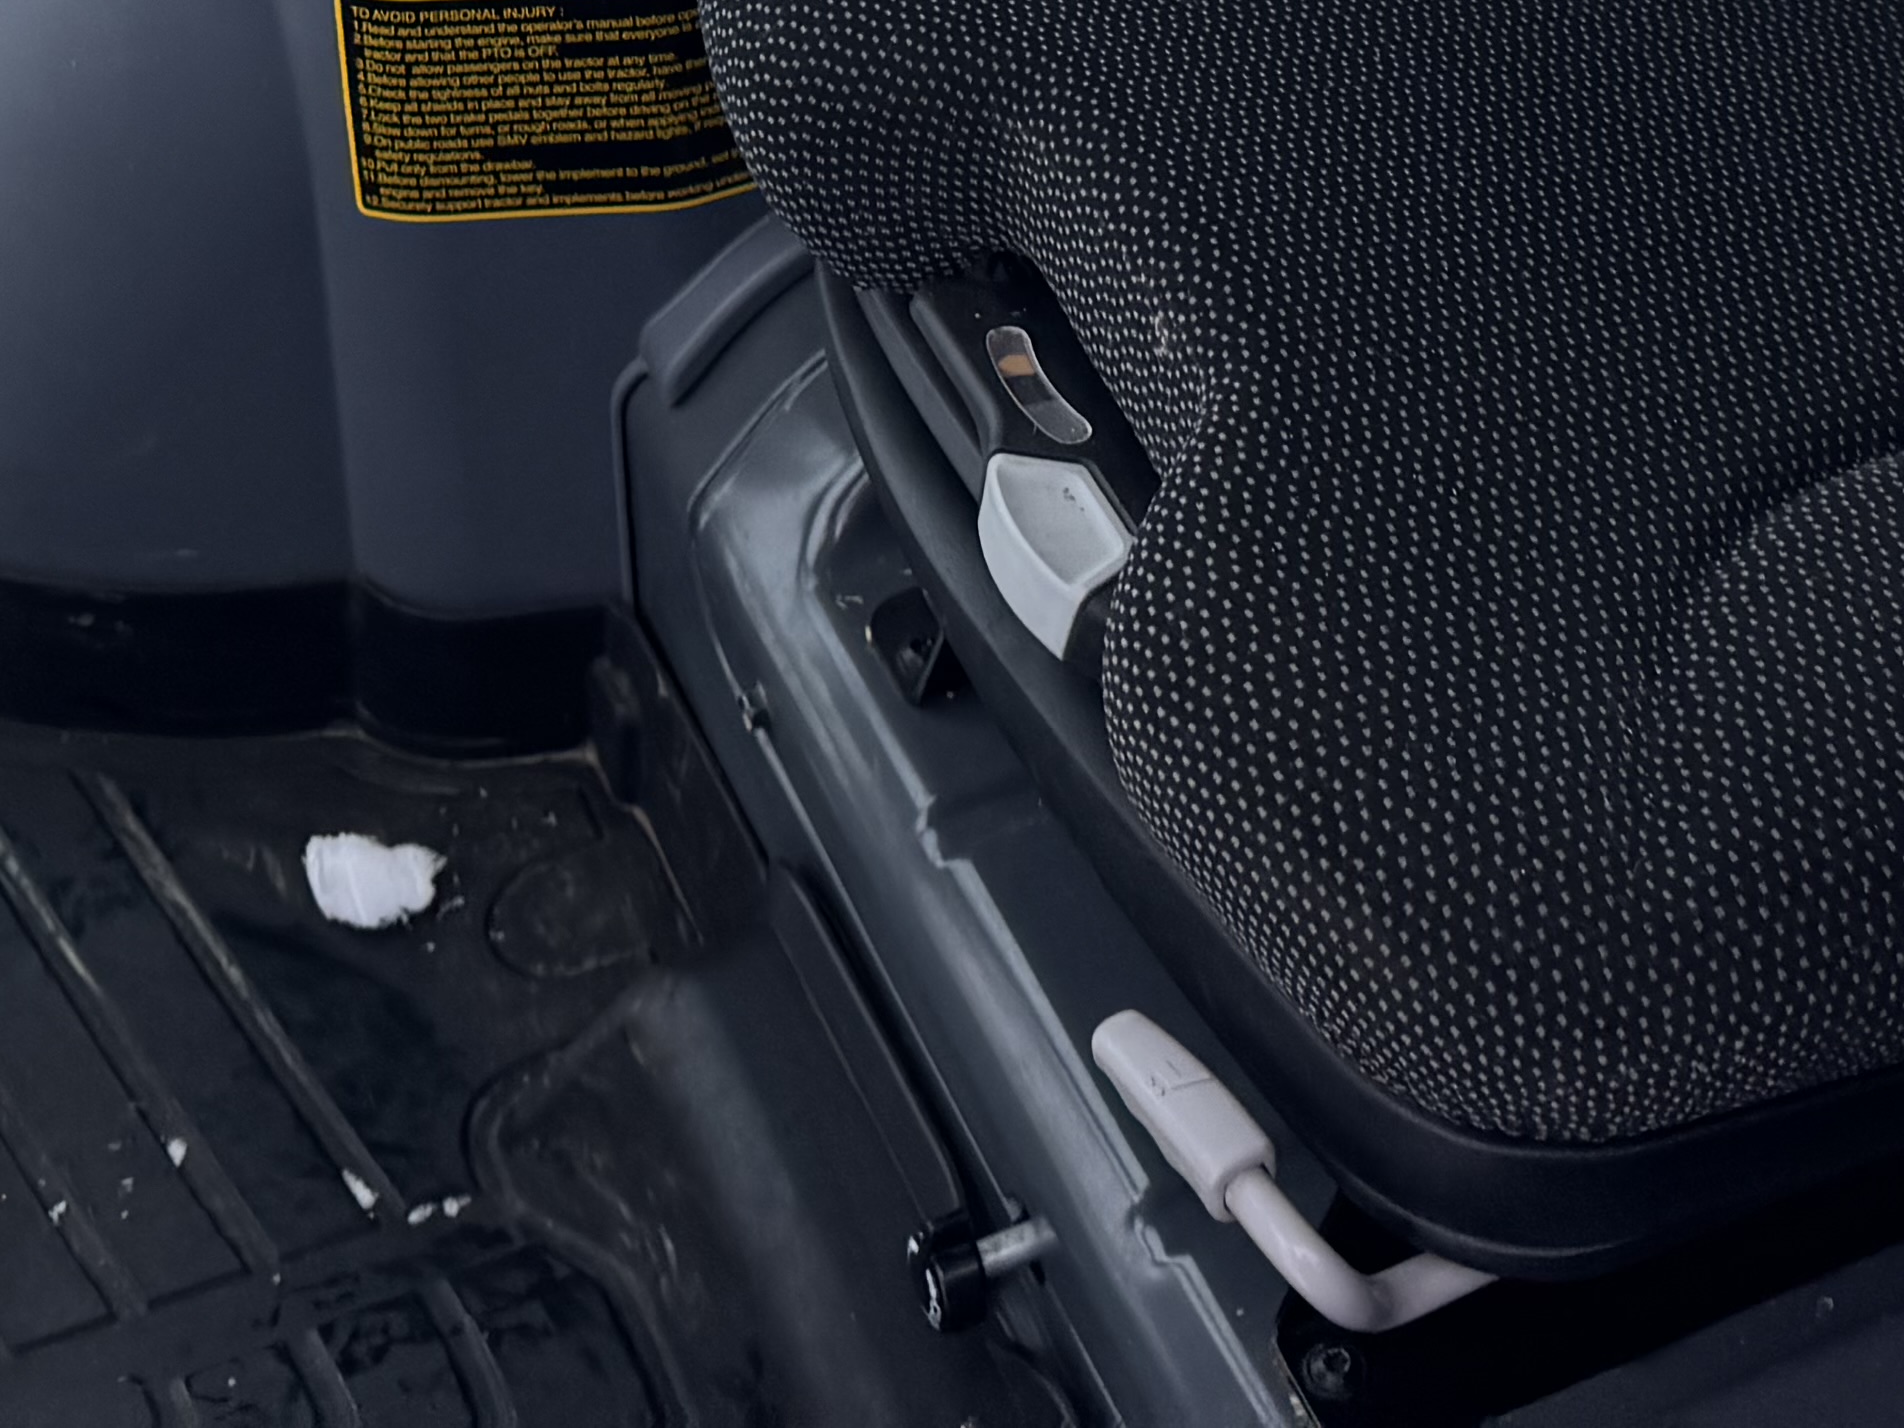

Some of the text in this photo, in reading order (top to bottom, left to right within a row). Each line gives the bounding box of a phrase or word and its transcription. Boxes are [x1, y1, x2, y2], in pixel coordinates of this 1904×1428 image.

[352, 5, 557, 24] TO AVOID PERSONAL INJURY
[397, 25, 422, 37] and
[425, 22, 495, 37] understand
[497, 21, 518, 34] the
[586, 15, 633, 30] manual
[636, 12, 676, 28] before
[455, 36, 476, 48] the
[595, 30, 620, 42] that
[622, 25, 680, 42] everyone
[386, 63, 406, 75] not
[412, 63, 444, 75] allow
[522, 59, 539, 71] on
[608, 54, 620, 68] at
[622, 54, 646, 68] any
[405, 50, 429, 63] and
[431, 50, 455, 62] that
[459, 49, 479, 61] the
[482, 46, 512, 60] PTO
